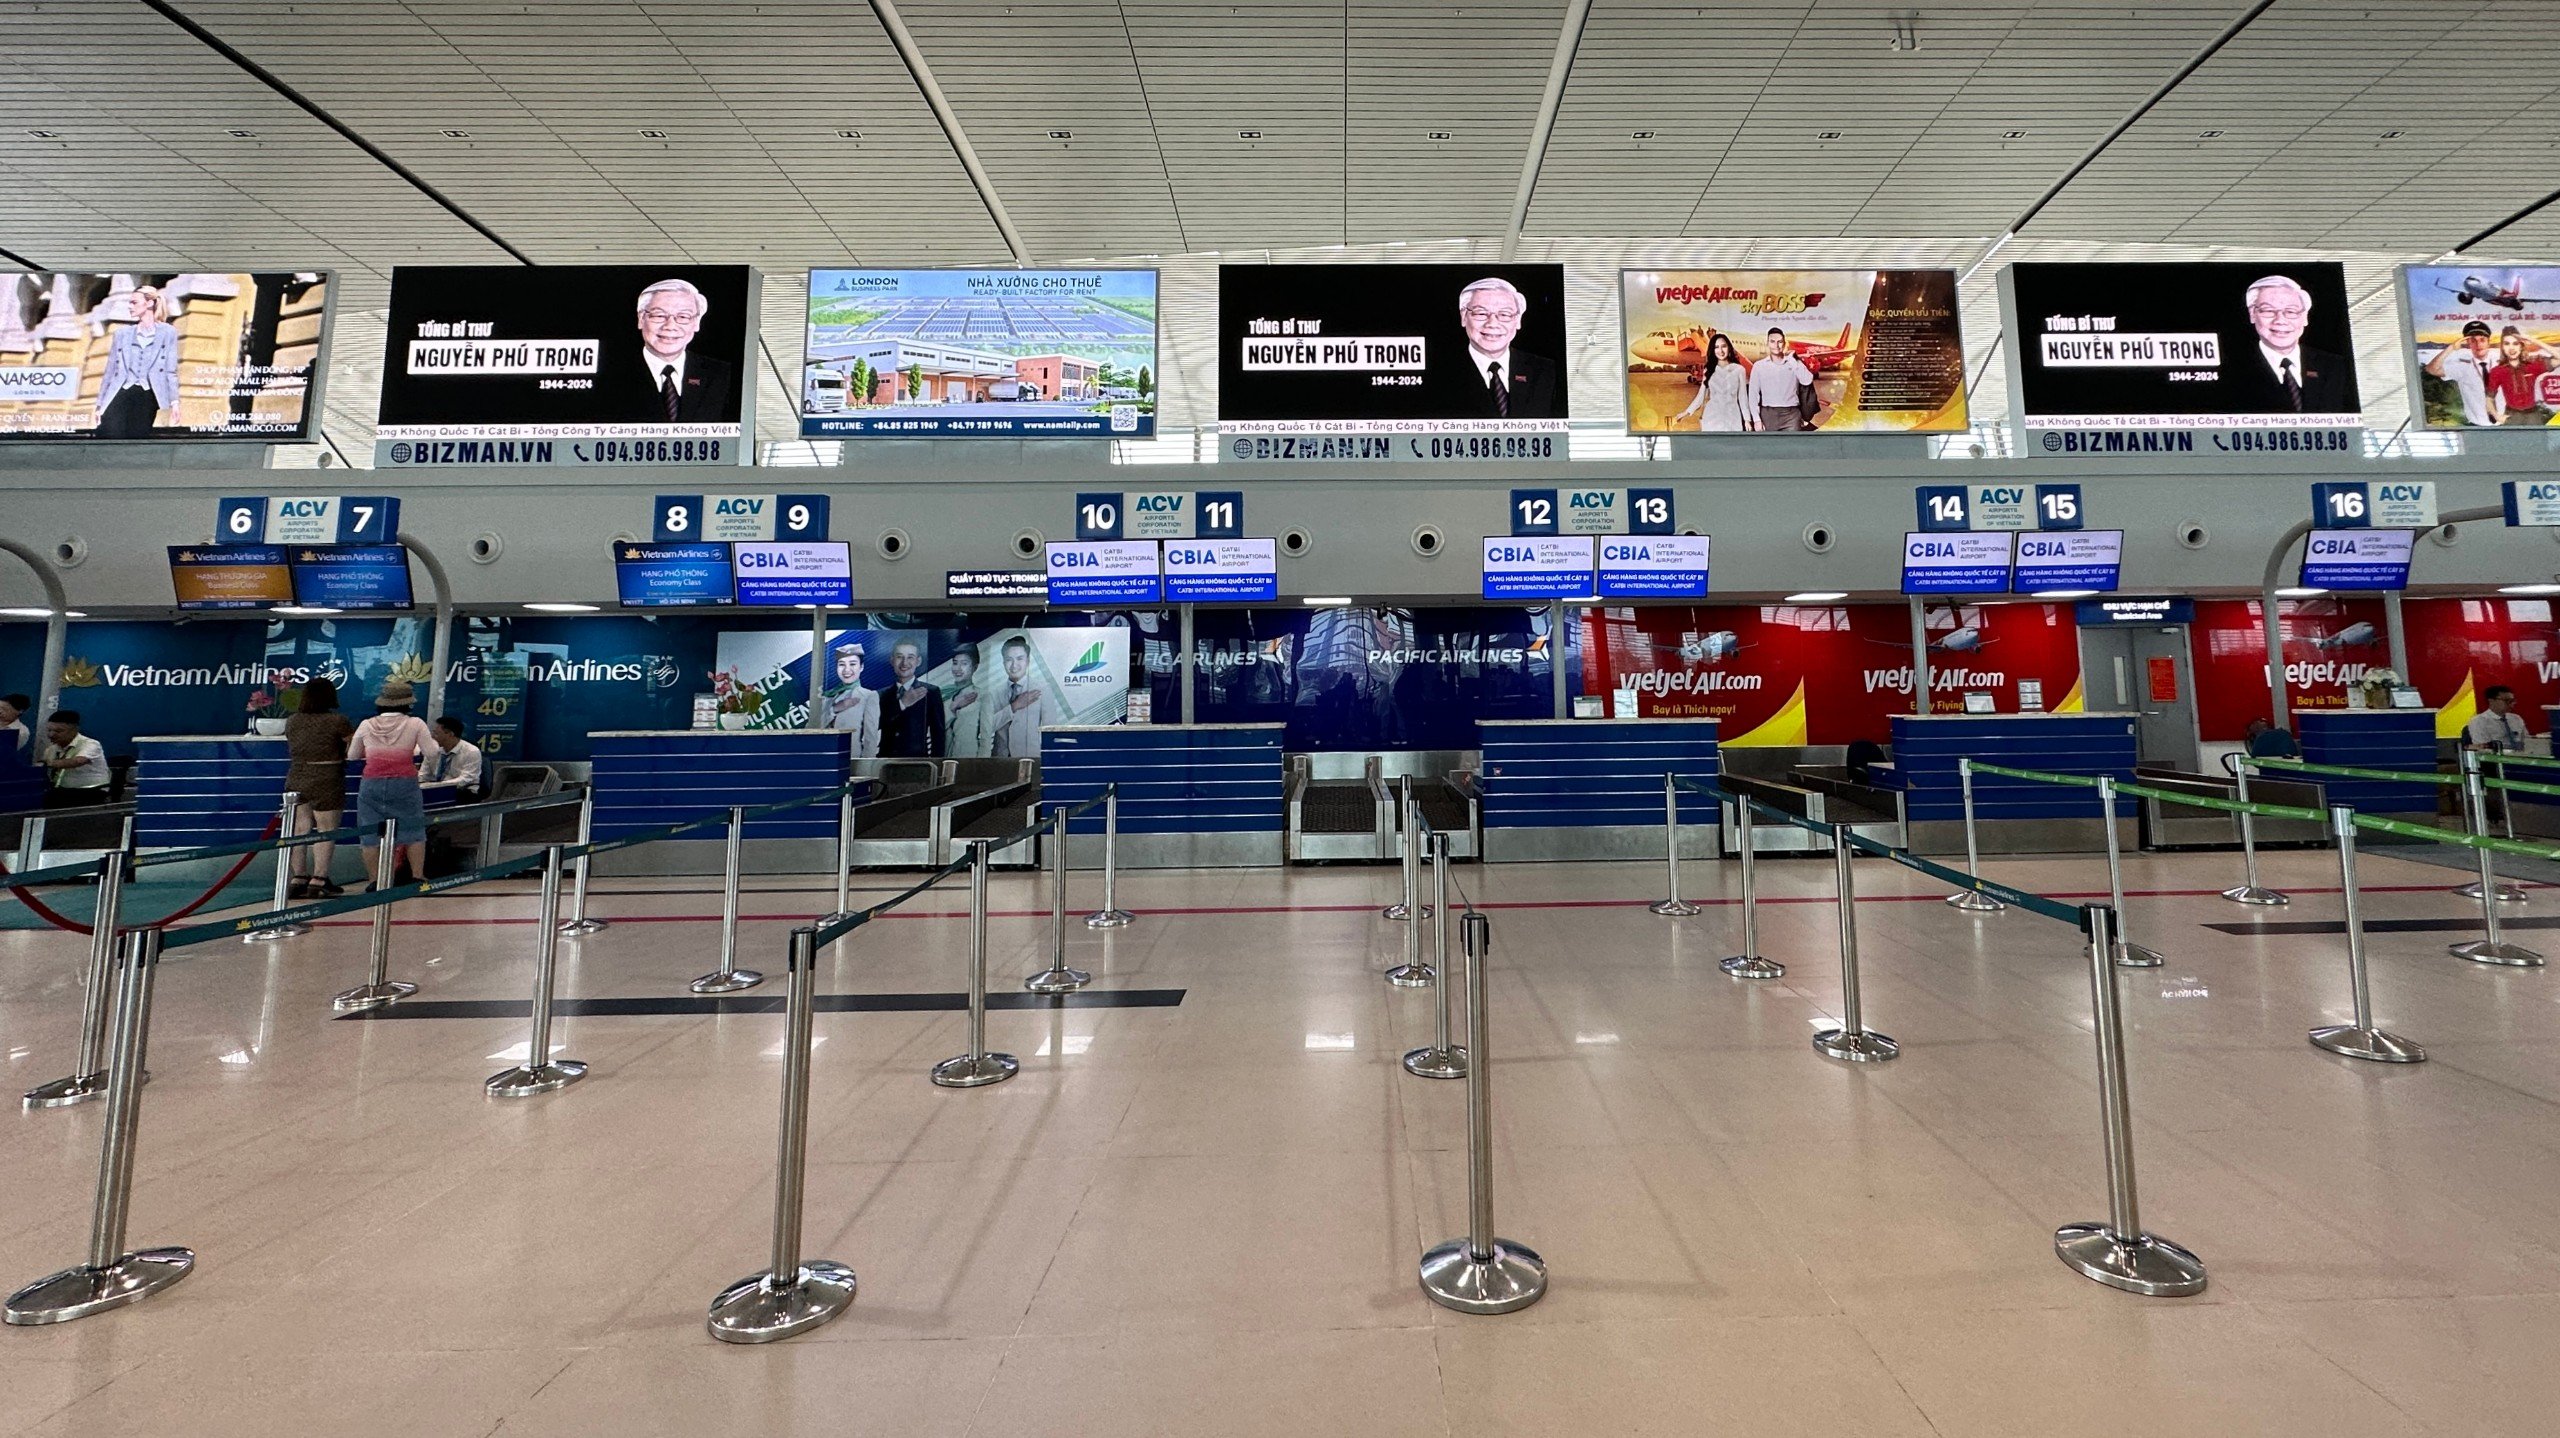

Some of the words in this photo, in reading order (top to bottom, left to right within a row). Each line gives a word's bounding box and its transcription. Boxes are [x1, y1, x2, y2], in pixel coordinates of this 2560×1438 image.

[852, 277, 898, 286] LONDON
[967, 275, 993, 288] NHÀ
[1042, 277, 1068, 288] CHO
[1072, 275, 1102, 287] THUÊ
[468, 321, 494, 337] THƯ
[1297, 319, 1321, 334] THƯ
[2092, 316, 2116, 331] THƯ
[414, 341, 485, 367] NGUYỄN
[492, 343, 528, 367] PHÚ
[536, 347, 594, 371] TRỌNG
[1248, 339, 1317, 364] NGUYỄN
[1323, 341, 1358, 364] PHÚ
[1364, 345, 1421, 368] TRỌNG
[2048, 335, 2114, 360] NGUYỄN
[2120, 337, 2154, 360] PHÚ
[2159, 341, 2215, 364] TRỌNG
[539, 379, 593, 390] 1944-2024
[1371, 376, 1423, 386] 1944-2024
[2168, 371, 2219, 381] 1944-2024
[821, 422, 864, 430] HOTLINE:
[1427, 422, 1438, 431] Ty
[1257, 437, 1389, 459] BIZMAN.VN
[1431, 437, 1552, 458] 094.986.98.98
[2064, 431, 2193, 452] BIZMAN.VN
[2231, 431, 2348, 451] 094.986.98.98
[415, 442, 553, 463] BIZMAN.VN
[595, 440, 720, 462] 094.986.98.98
[1569, 492, 1615, 508] ACV
[1979, 488, 2024, 505] ACV
[2379, 486, 2423, 501] ACV
[279, 500, 329, 517] ACV
[715, 498, 764, 515] ACV
[1136, 495, 1183, 512] ACV
[1518, 499, 1551, 525] 12
[1634, 498, 1668, 524] 13
[1928, 495, 1965, 522] 14
[2041, 493, 2077, 520] 15
[2329, 492, 2364, 518] 16
[229, 507, 252, 534] 6
[352, 506, 374, 533] 7
[665, 505, 689, 531] 8
[788, 504, 810, 531] 9
[1081, 502, 1116, 530] 10
[1204, 501, 1234, 528] 11
[1488, 547, 1535, 562] CBIA
[1603, 545, 1651, 560] CBIA
[1909, 542, 1955, 557] CBIA
[2021, 541, 2066, 557] CBIA
[2311, 540, 2356, 554] CBIA
[739, 552, 789, 568] CBIA
[1050, 551, 1100, 568] CBIA
[1168, 549, 1217, 565] CBIA
[949, 586, 982, 595] Domestic
[1172, 651, 1257, 666] ARLINES
[1368, 649, 1437, 664] PACIFIC
[1439, 648, 1523, 664] AIRLINES
[1064, 675, 1112, 683] BAMBOO
[477, 697, 508, 716] 40
[1653, 704, 1670, 715] Bay
[1673, 704, 1681, 714] là
[1710, 704, 1736, 715] ngay!
[2297, 696, 2314, 706] Bay
